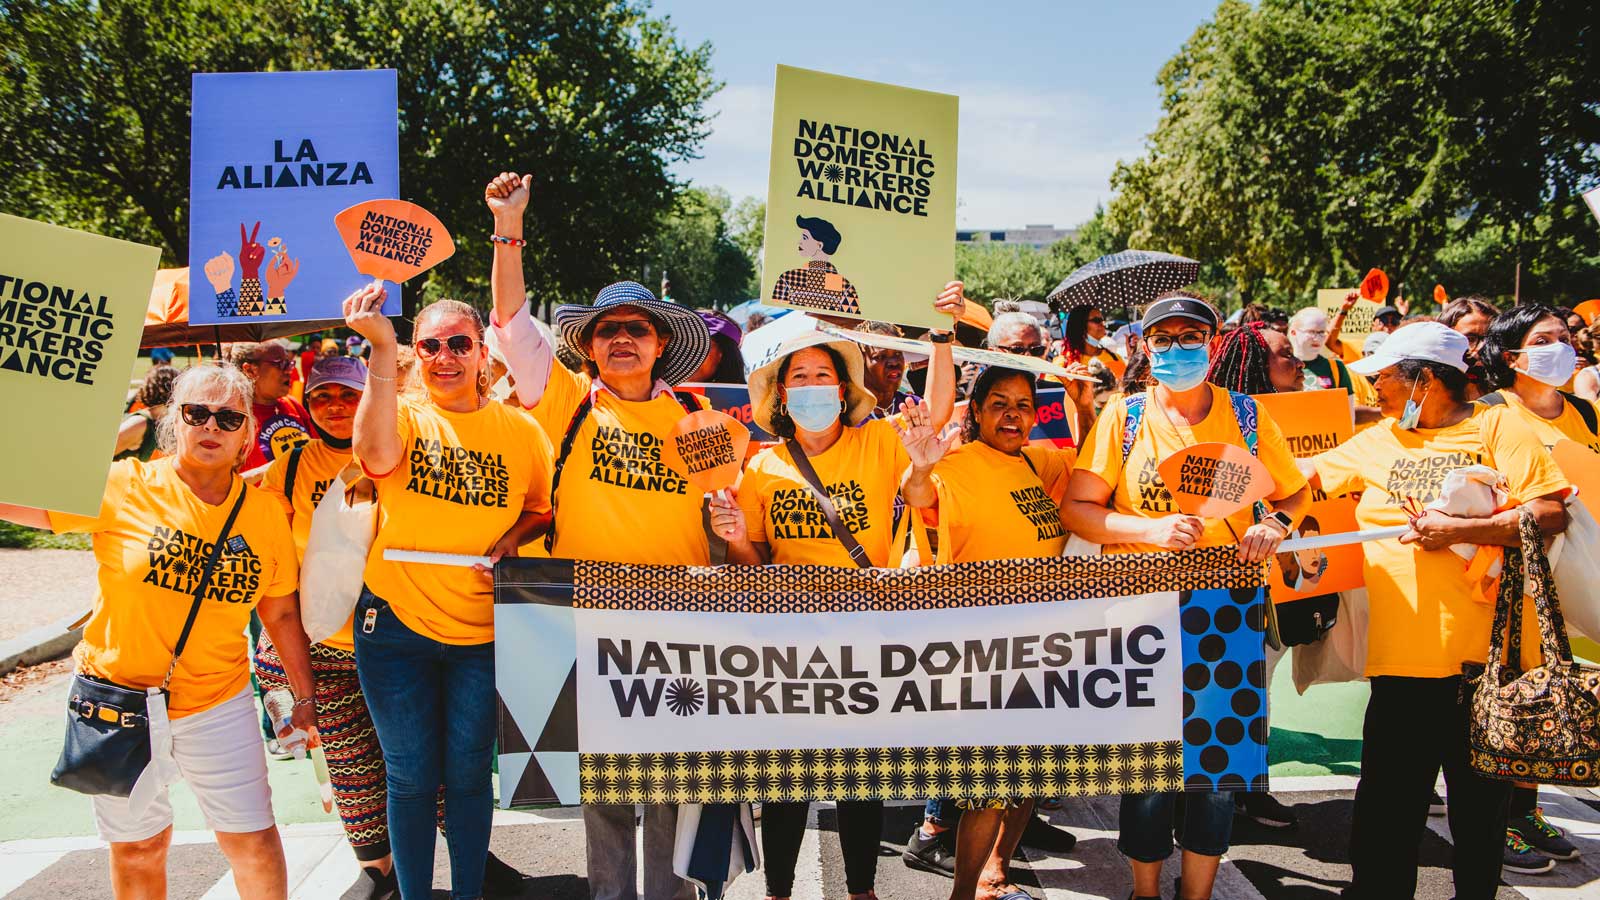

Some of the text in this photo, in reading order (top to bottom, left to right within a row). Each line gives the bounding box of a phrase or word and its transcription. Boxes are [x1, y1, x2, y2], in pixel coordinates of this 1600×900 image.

[274, 138, 319, 162] LA
[798, 118, 933, 159] NATIONAL
[794, 137, 935, 179] DOMESTIC
[216, 161, 374, 190] ALIANZA
[797, 158, 931, 197] WORKERS
[797, 179, 928, 217] ALLIANCE
[360, 219, 433, 248] DOMESTIC
[365, 210, 433, 239] NATIONAL
[355, 240, 424, 268] ALLIANCE
[360, 230, 427, 257] WORKERS
[259, 420, 285, 441] Home
[675, 422, 728, 447] NATIONAL
[677, 431, 732, 457] DOMESTIC
[410, 450, 510, 481] DOMESTIC
[415, 436, 507, 469] NATIONAL
[682, 442, 734, 465] WORKERS
[688, 452, 737, 475] ALLIANCE
[1185, 454, 1252, 477] NATIONAL
[410, 463, 509, 493] WORKERS
[589, 466, 689, 495] ALLIANCE
[1180, 464, 1251, 486] DOMESTIC
[1180, 473, 1247, 495] WORKERS
[406, 477, 508, 508] ALLIANCE
[1177, 484, 1245, 504] ALLIANCE
[597, 624, 1167, 680] NATIONAL DOMESTIC
[609, 668, 1156, 718] WORKERS ALLIANCE
